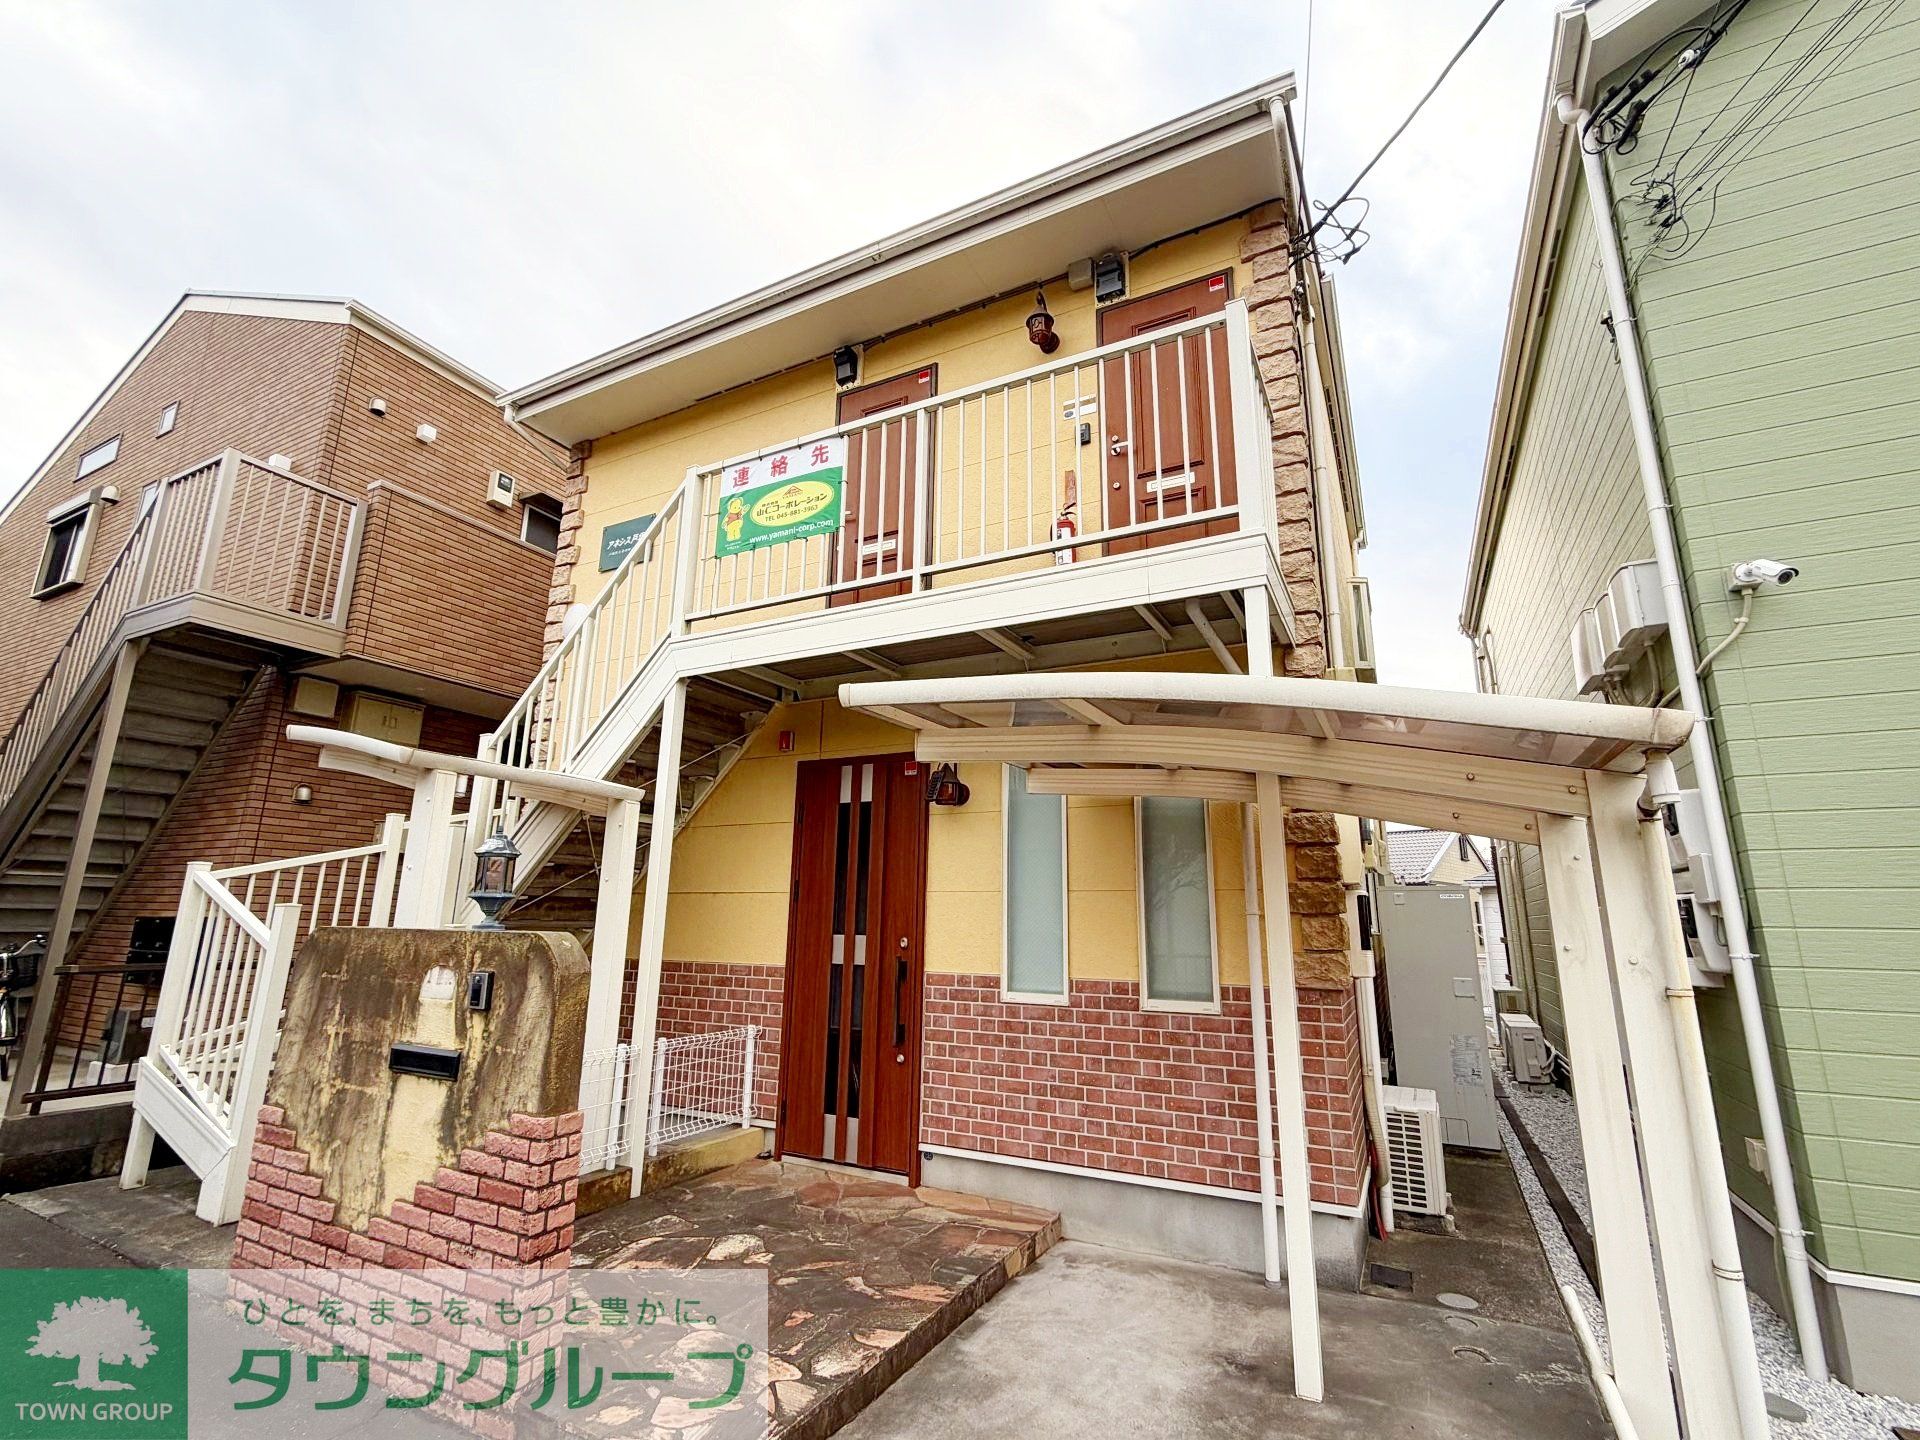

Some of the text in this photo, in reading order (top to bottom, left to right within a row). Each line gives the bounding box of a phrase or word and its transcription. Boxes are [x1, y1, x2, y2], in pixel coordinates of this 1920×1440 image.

[732, 444, 829, 488] 連絡先
[749, 519, 834, 544] www.yamani-corp.com
